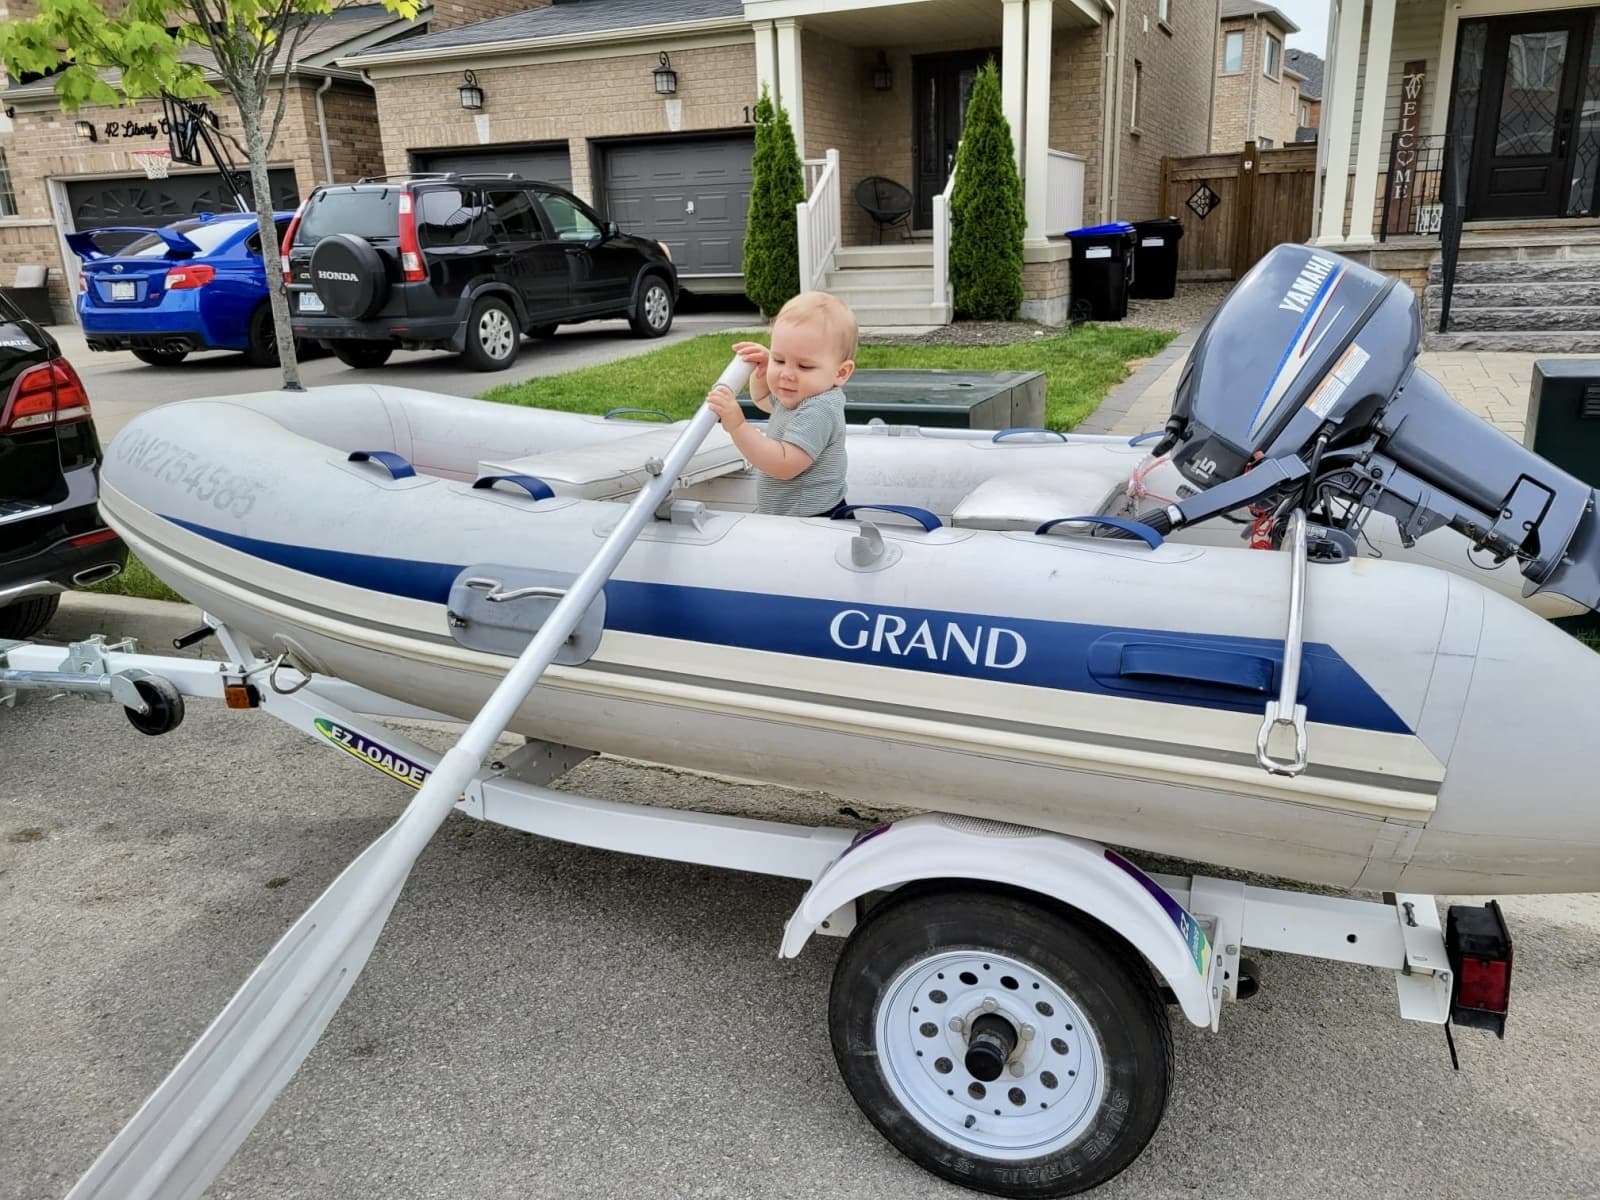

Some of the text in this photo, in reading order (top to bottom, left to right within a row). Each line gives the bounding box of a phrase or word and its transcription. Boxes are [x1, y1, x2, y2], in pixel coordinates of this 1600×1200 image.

[104, 122, 119, 137] 42
[121, 121, 158, 139] Liberty
[317, 270, 359, 282] HONDA
[1279, 255, 1335, 313] YAMAHA
[1195, 456, 1217, 479] 15
[829, 609, 1028, 670] GRAND
[331, 725, 354, 748] EZ
